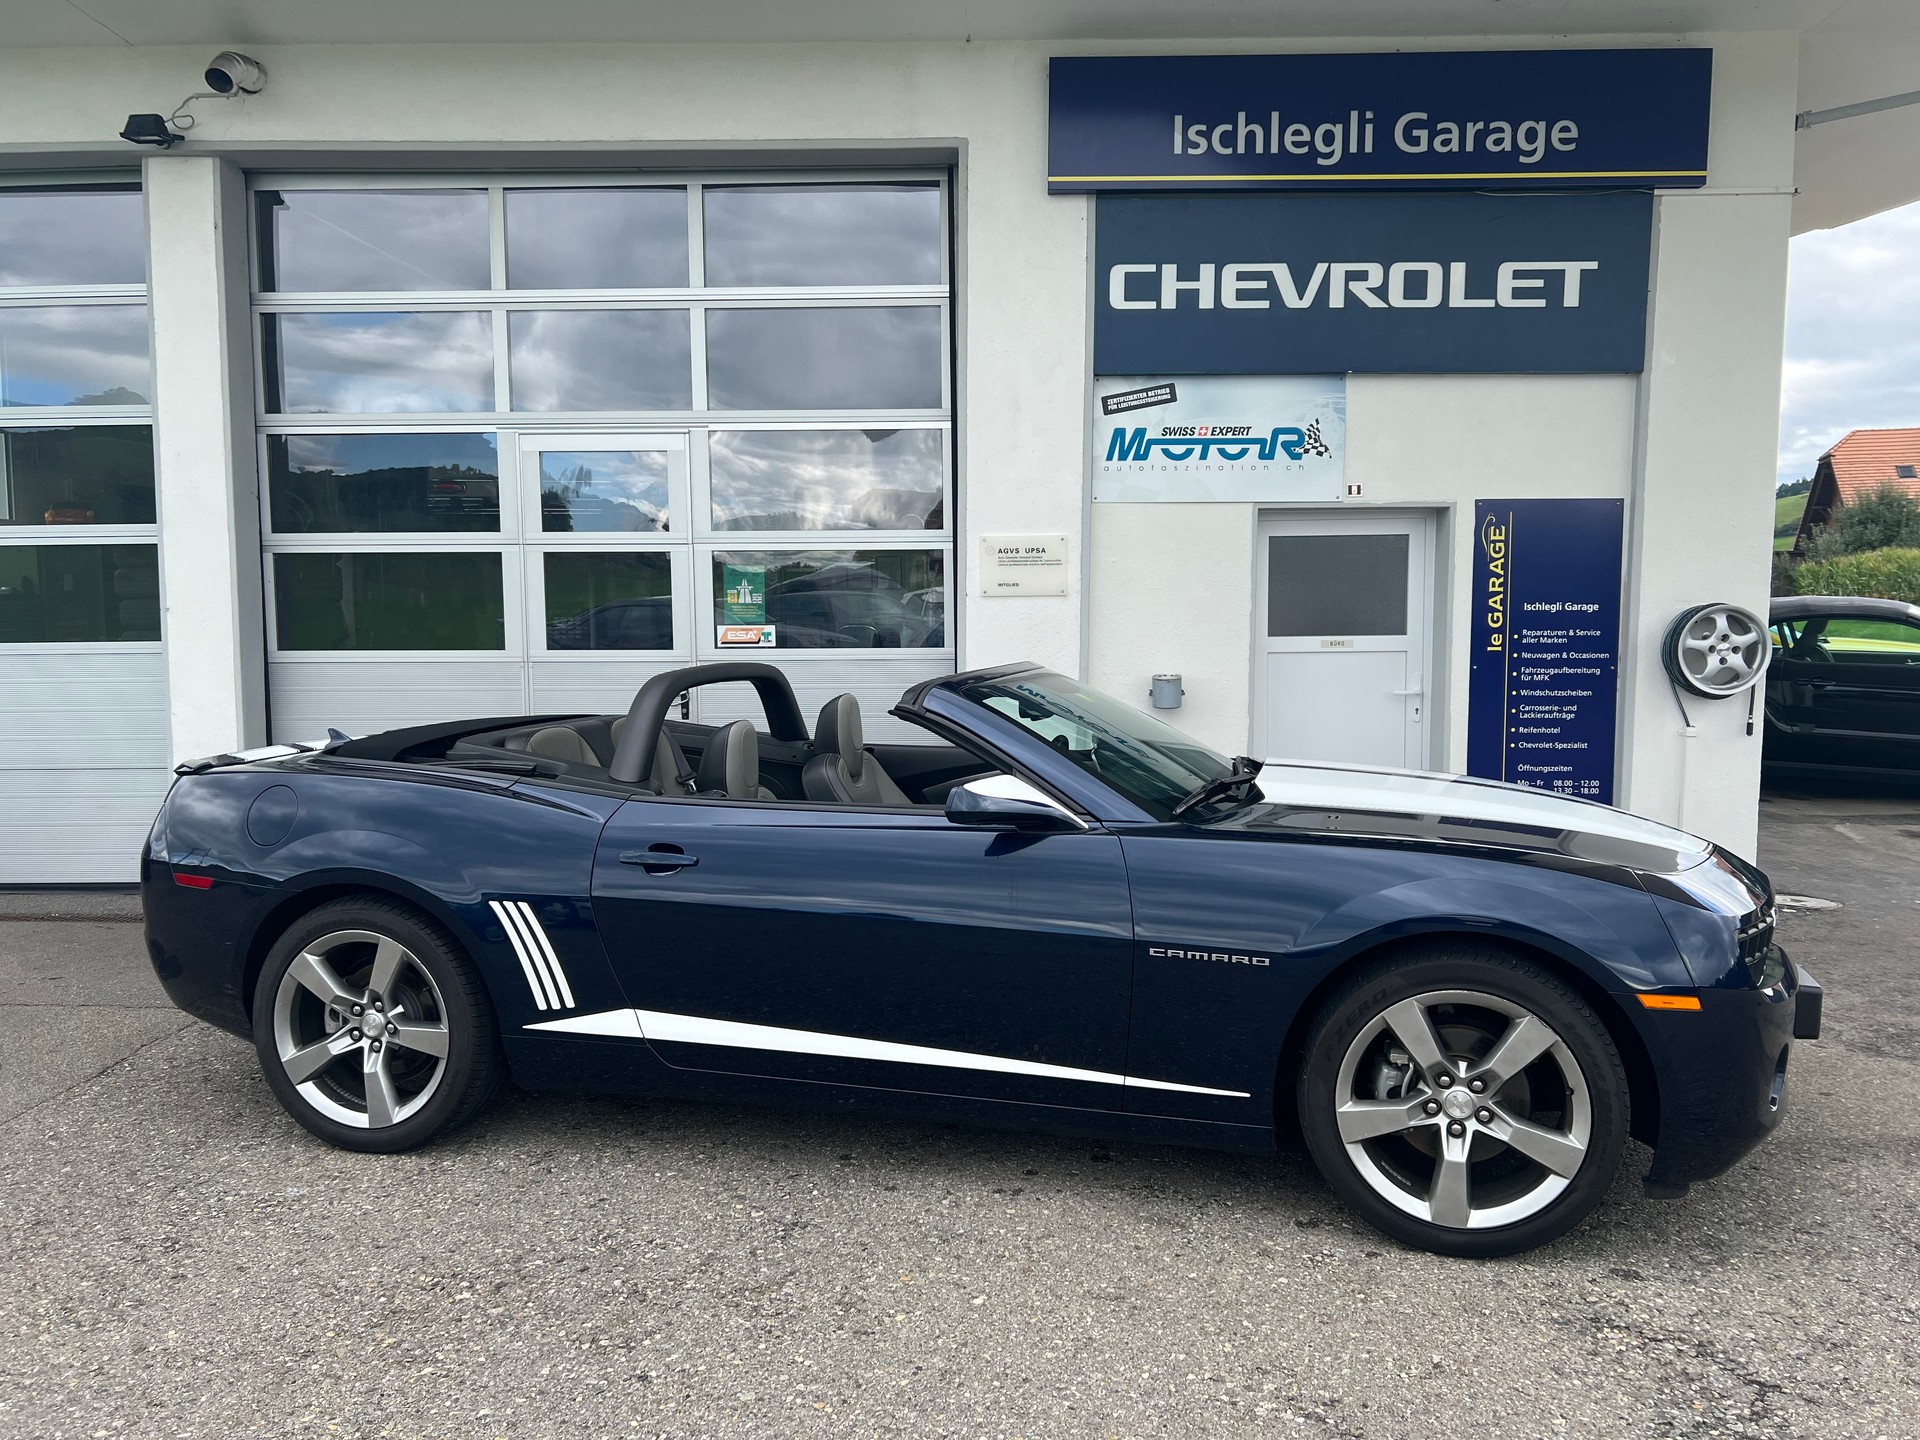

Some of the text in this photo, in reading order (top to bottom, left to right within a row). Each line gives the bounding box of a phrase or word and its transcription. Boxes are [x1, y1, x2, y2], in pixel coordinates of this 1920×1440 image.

[1173, 110, 1579, 166] Ischlegli Garage
[1108, 260, 1599, 310] CHEVROLET
[1107, 387, 1171, 405] ZERTIFIZIERTER BETRIEB
[1161, 426, 1253, 437] SWISS EXPERT
[1103, 463, 1305, 472] autofaszination.ch
[1487, 524, 1506, 652] le GARAGE
[1523, 602, 1600, 613] Ischlegli Garage
[1522, 629, 1567, 638] Reparaturen
[1521, 652, 1560, 660] Neuwagen
[1521, 667, 1601, 676] Fahrzeugaufbereitung
[1520, 689, 1593, 697] Windschutzscheiben
[1519, 712, 1576, 720] Lackieraufträge
[1519, 726, 1561, 734] Reifenhotel
[1518, 742, 1588, 750] Chevrolet-Spezialist
[1517, 763, 1573, 773] Öffnungszeiten
[1553, 787, 1573, 795] 13.30
[1580, 787, 1600, 795] 18.00
[1149, 947, 1271, 966] CAMARO
